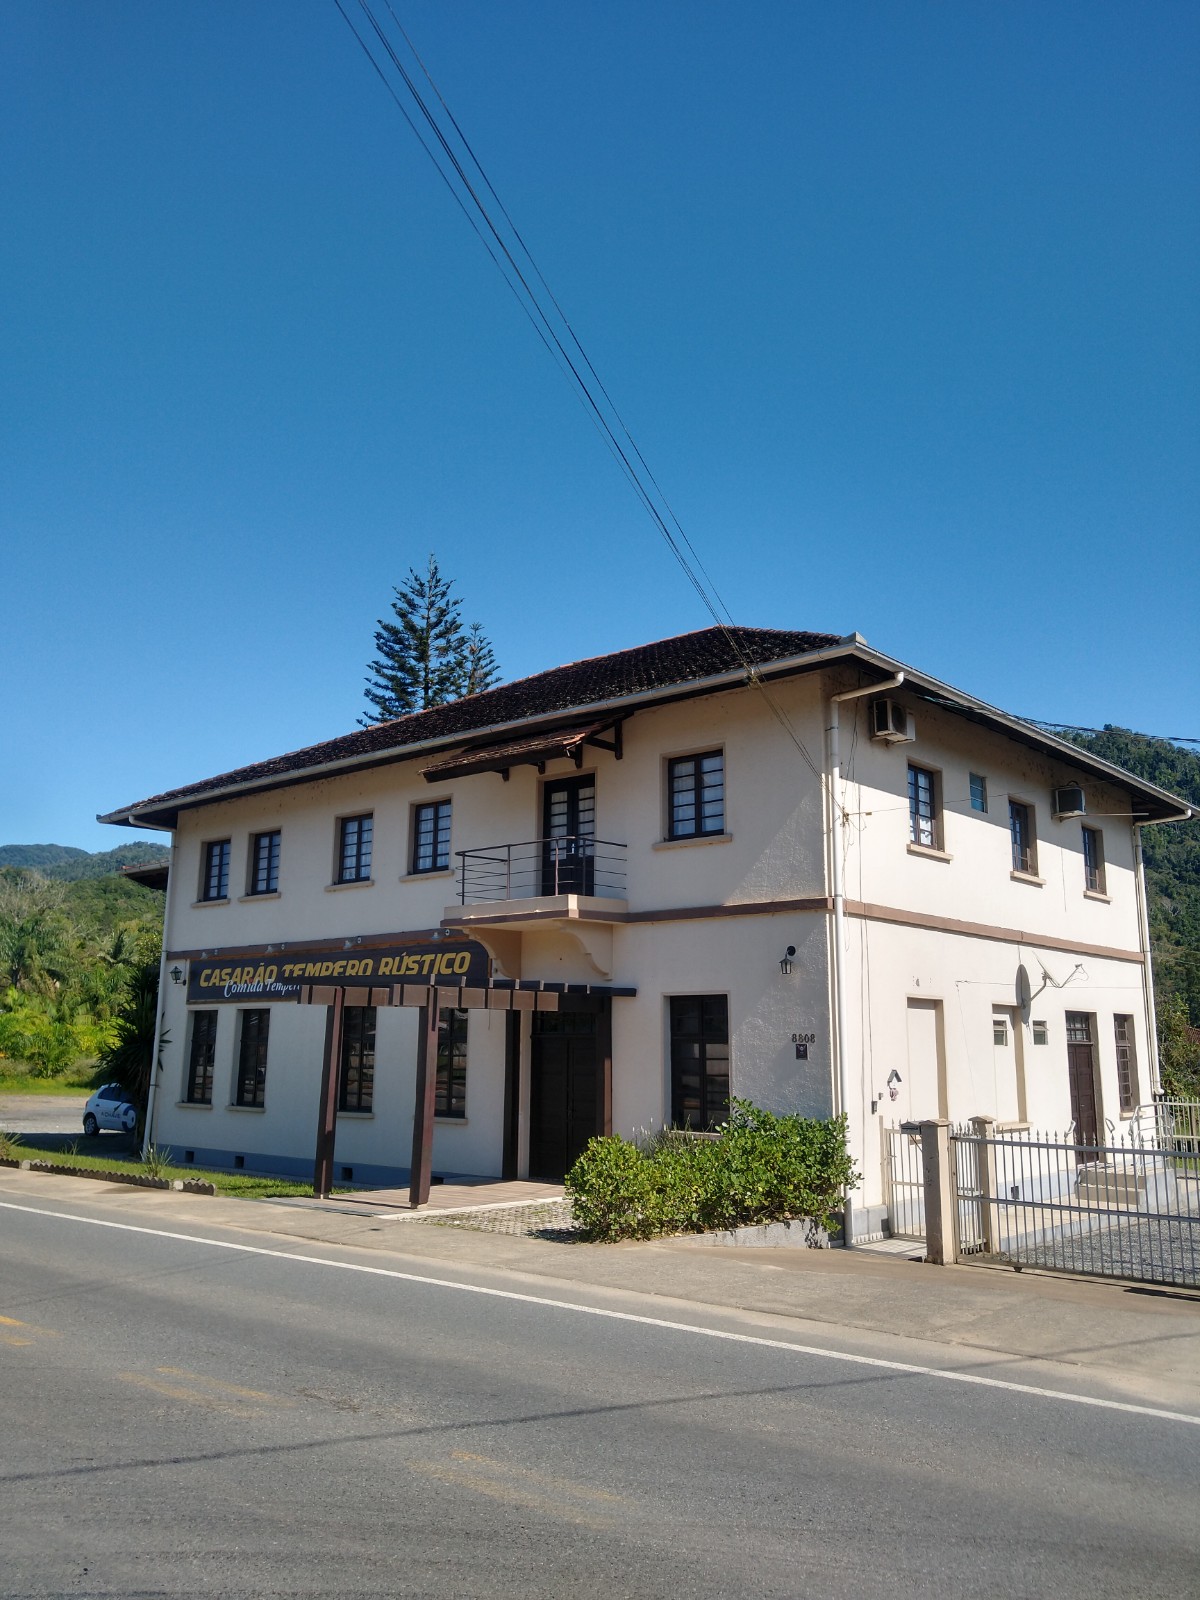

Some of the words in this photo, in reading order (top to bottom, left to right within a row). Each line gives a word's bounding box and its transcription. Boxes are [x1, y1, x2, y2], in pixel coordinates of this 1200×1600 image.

[199, 962, 278, 987] CASARÃO
[377, 951, 472, 975] RÚSTICO
[224, 979, 263, 998] Comida
[791, 1033, 816, 1044] 8808
